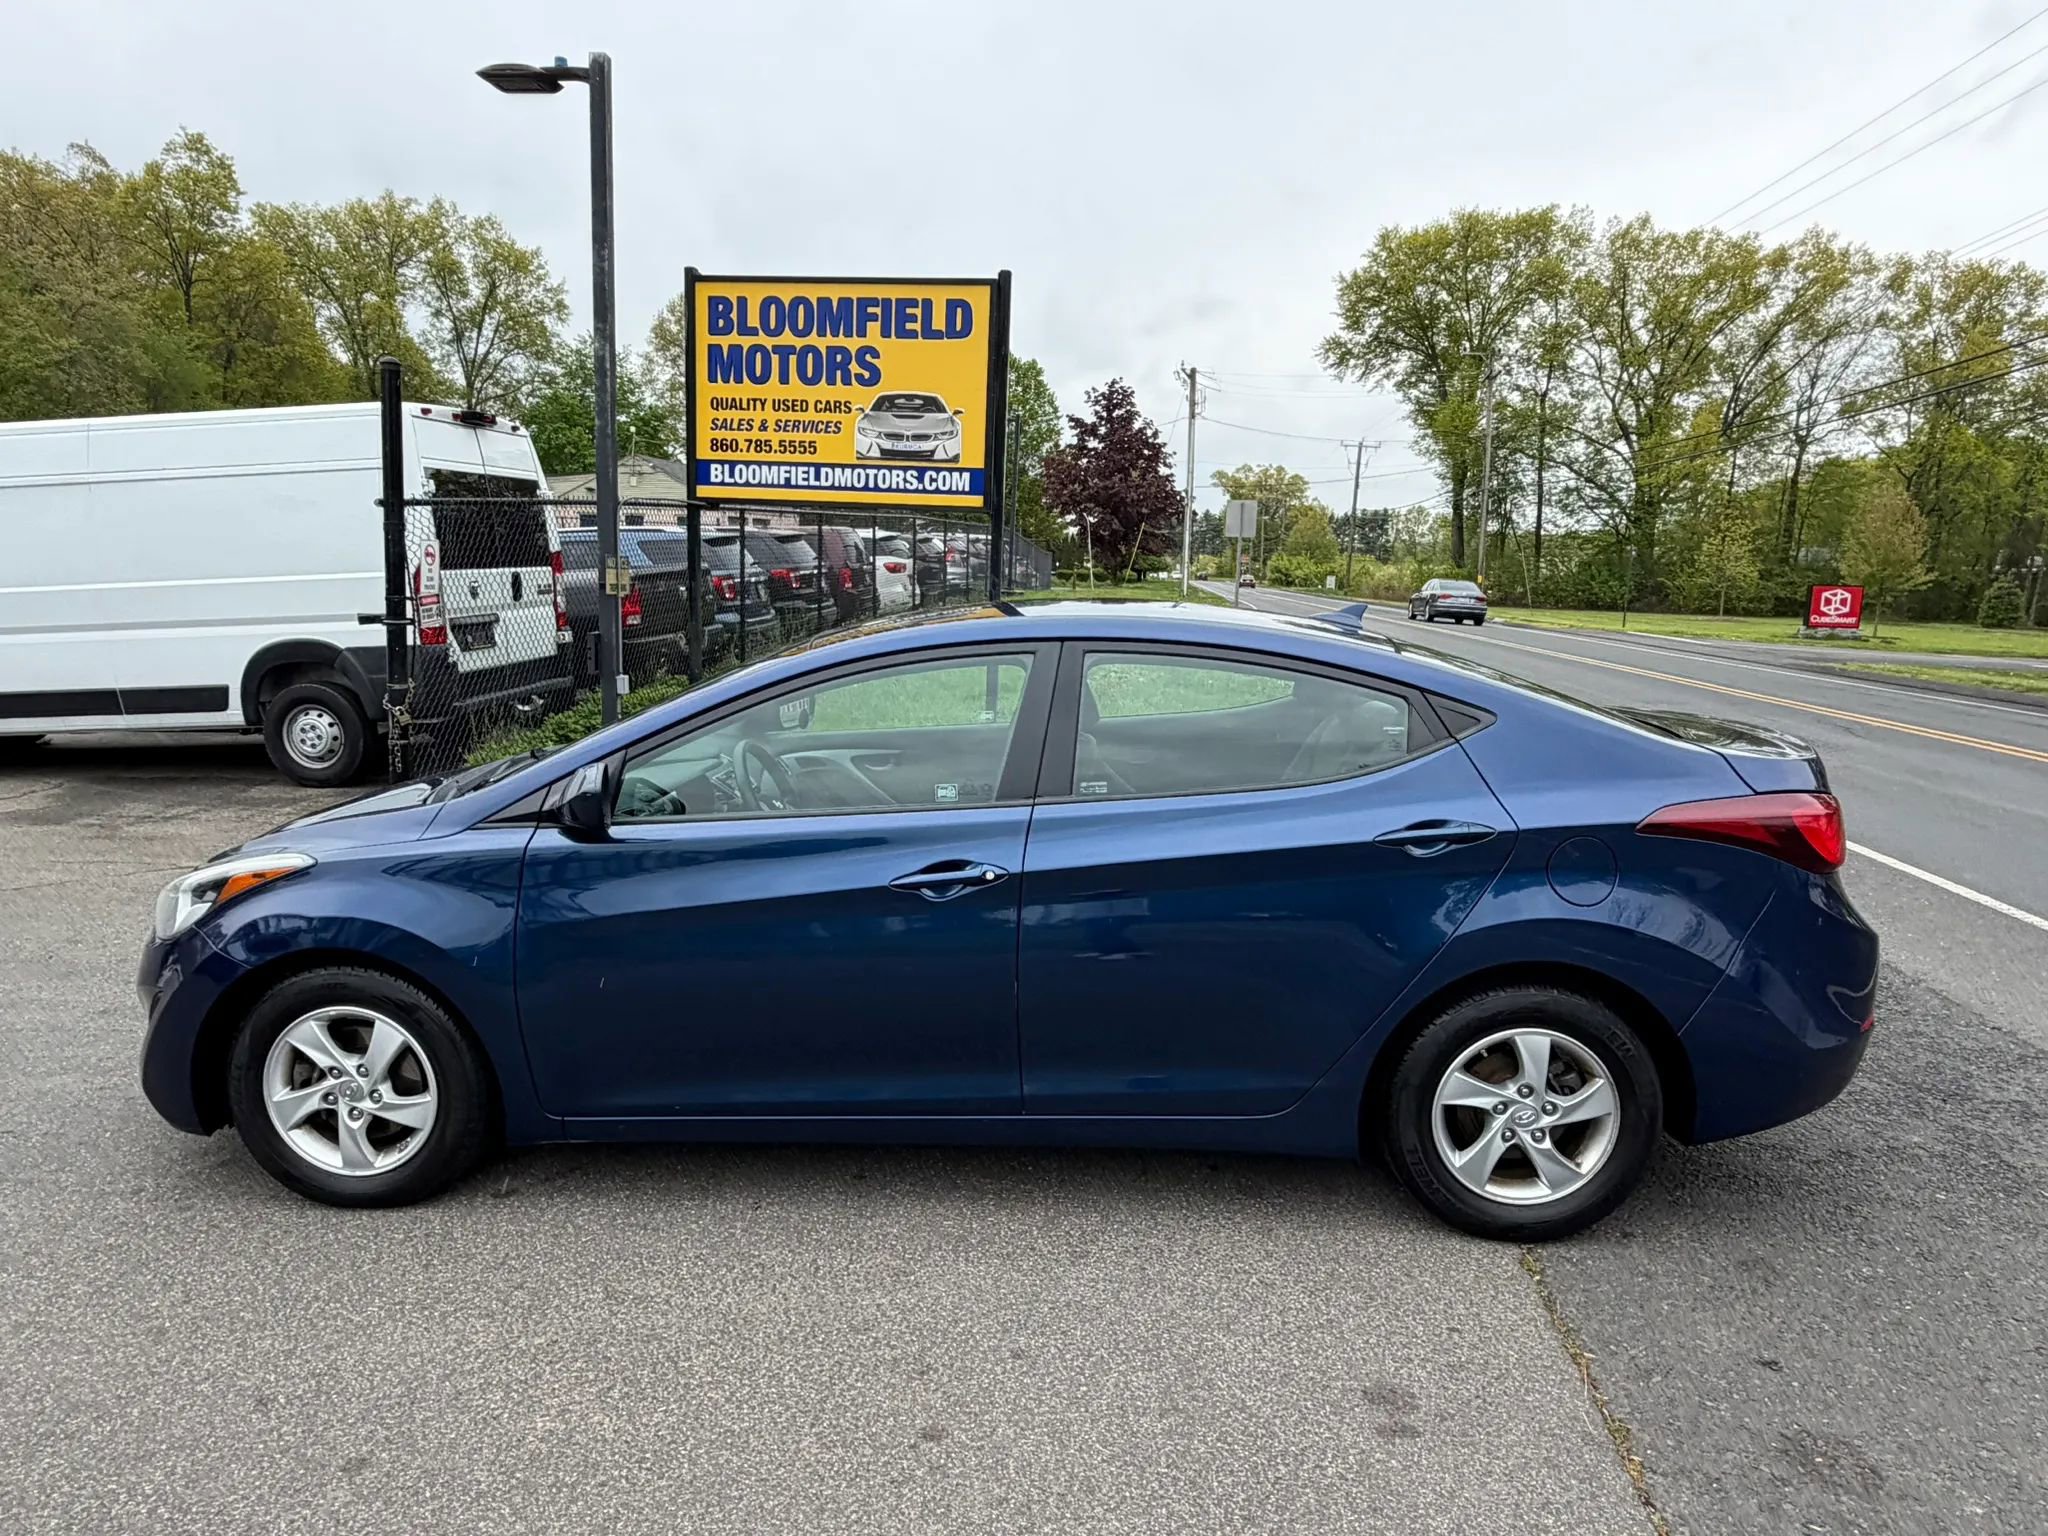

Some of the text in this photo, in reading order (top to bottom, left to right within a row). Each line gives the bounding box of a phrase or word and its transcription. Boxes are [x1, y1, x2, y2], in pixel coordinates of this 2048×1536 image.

[707, 295, 973, 339] BLOOMFIELD
[707, 344, 882, 387] MOTORS
[710, 397, 852, 414] QUALITY USED CARS
[710, 418, 842, 434] SALES & SERVICES
[710, 438, 818, 455] 860.785.5555
[710, 463, 970, 492] BLOOMFIELDMOTORS.COM
